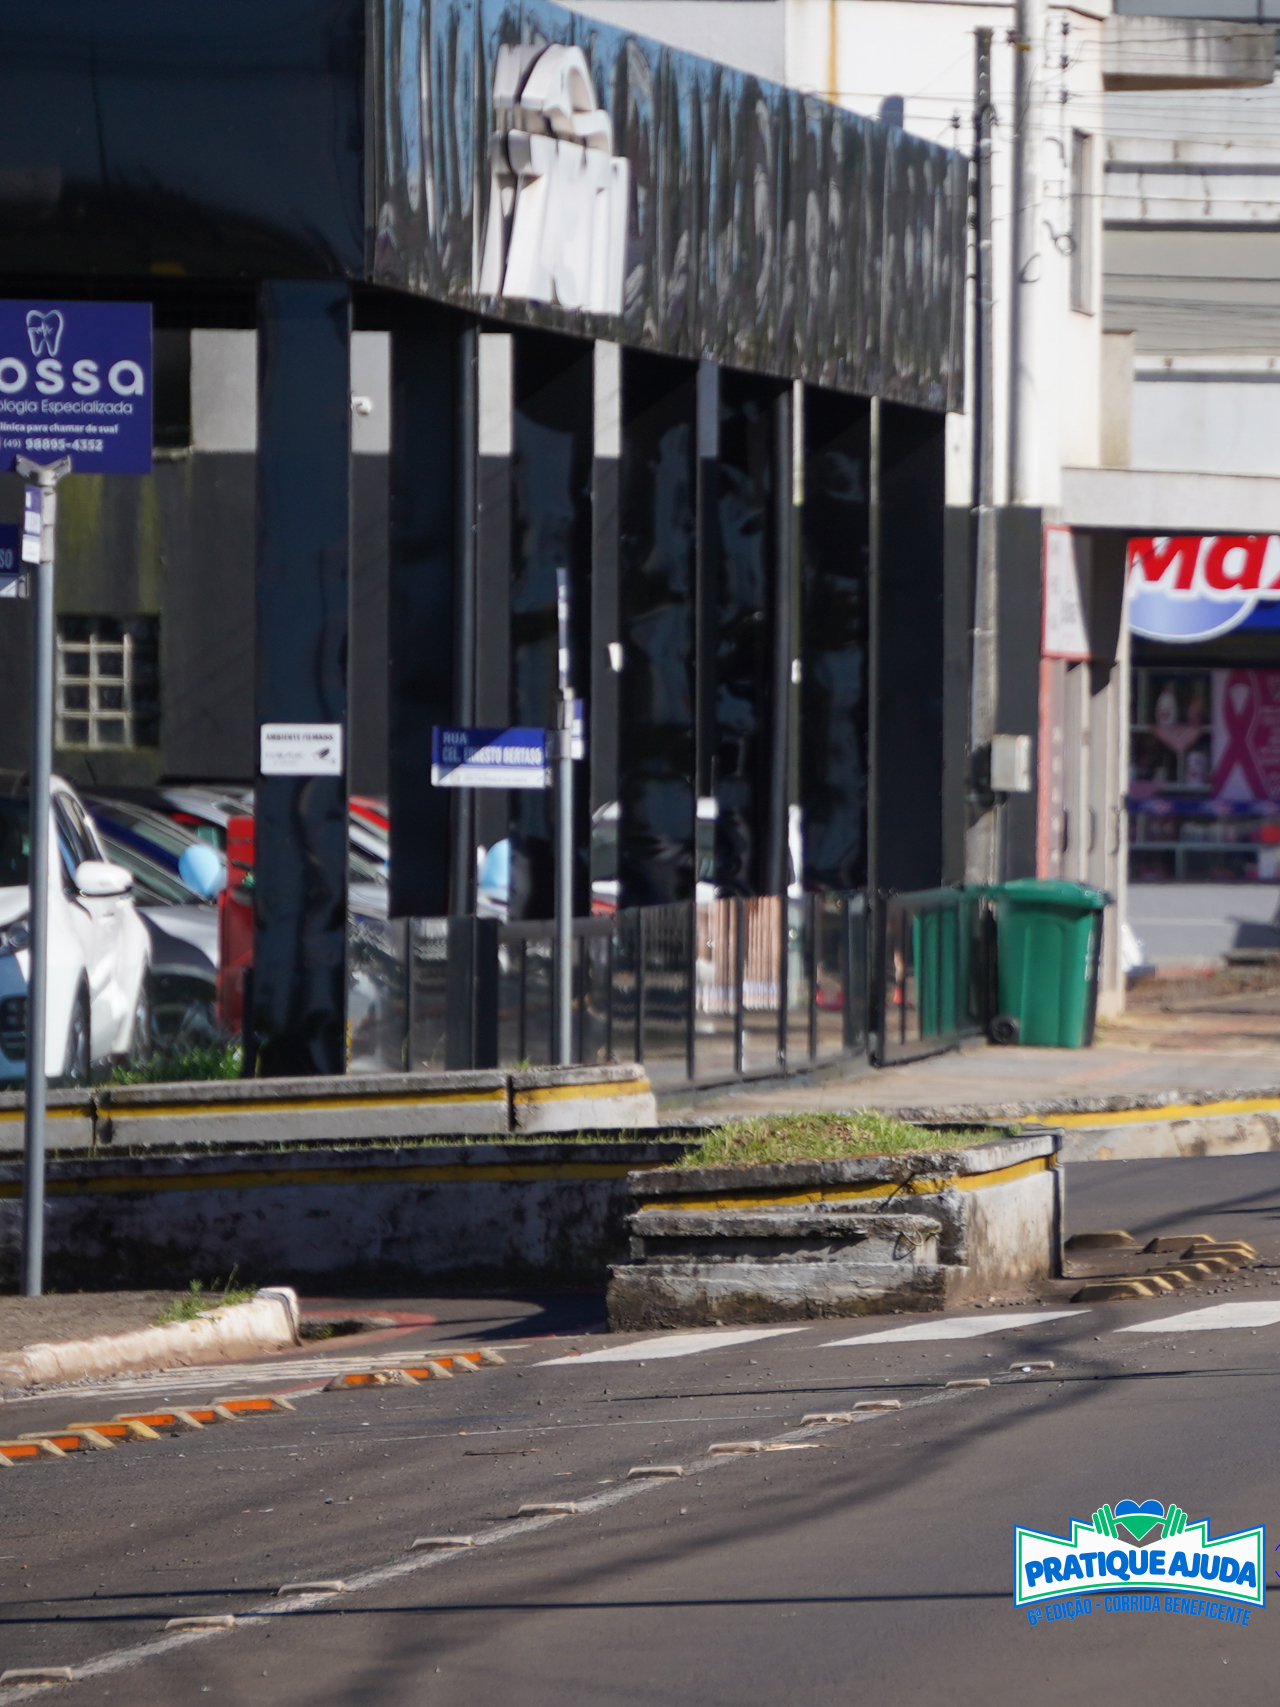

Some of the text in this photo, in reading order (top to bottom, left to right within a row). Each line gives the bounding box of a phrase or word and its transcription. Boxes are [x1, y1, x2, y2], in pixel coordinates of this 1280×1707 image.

[0, 357, 144, 396] ossa
[41, 399, 134, 416] Especializada
[26, 424, 48, 434] para
[49, 422, 84, 434] chamar
[85, 424, 97, 433] de
[3, 438, 21, 449] (49)
[442, 731, 467, 744] RUA
[442, 746, 461, 764] CEL.
[503, 747, 543, 766] BERTASO
